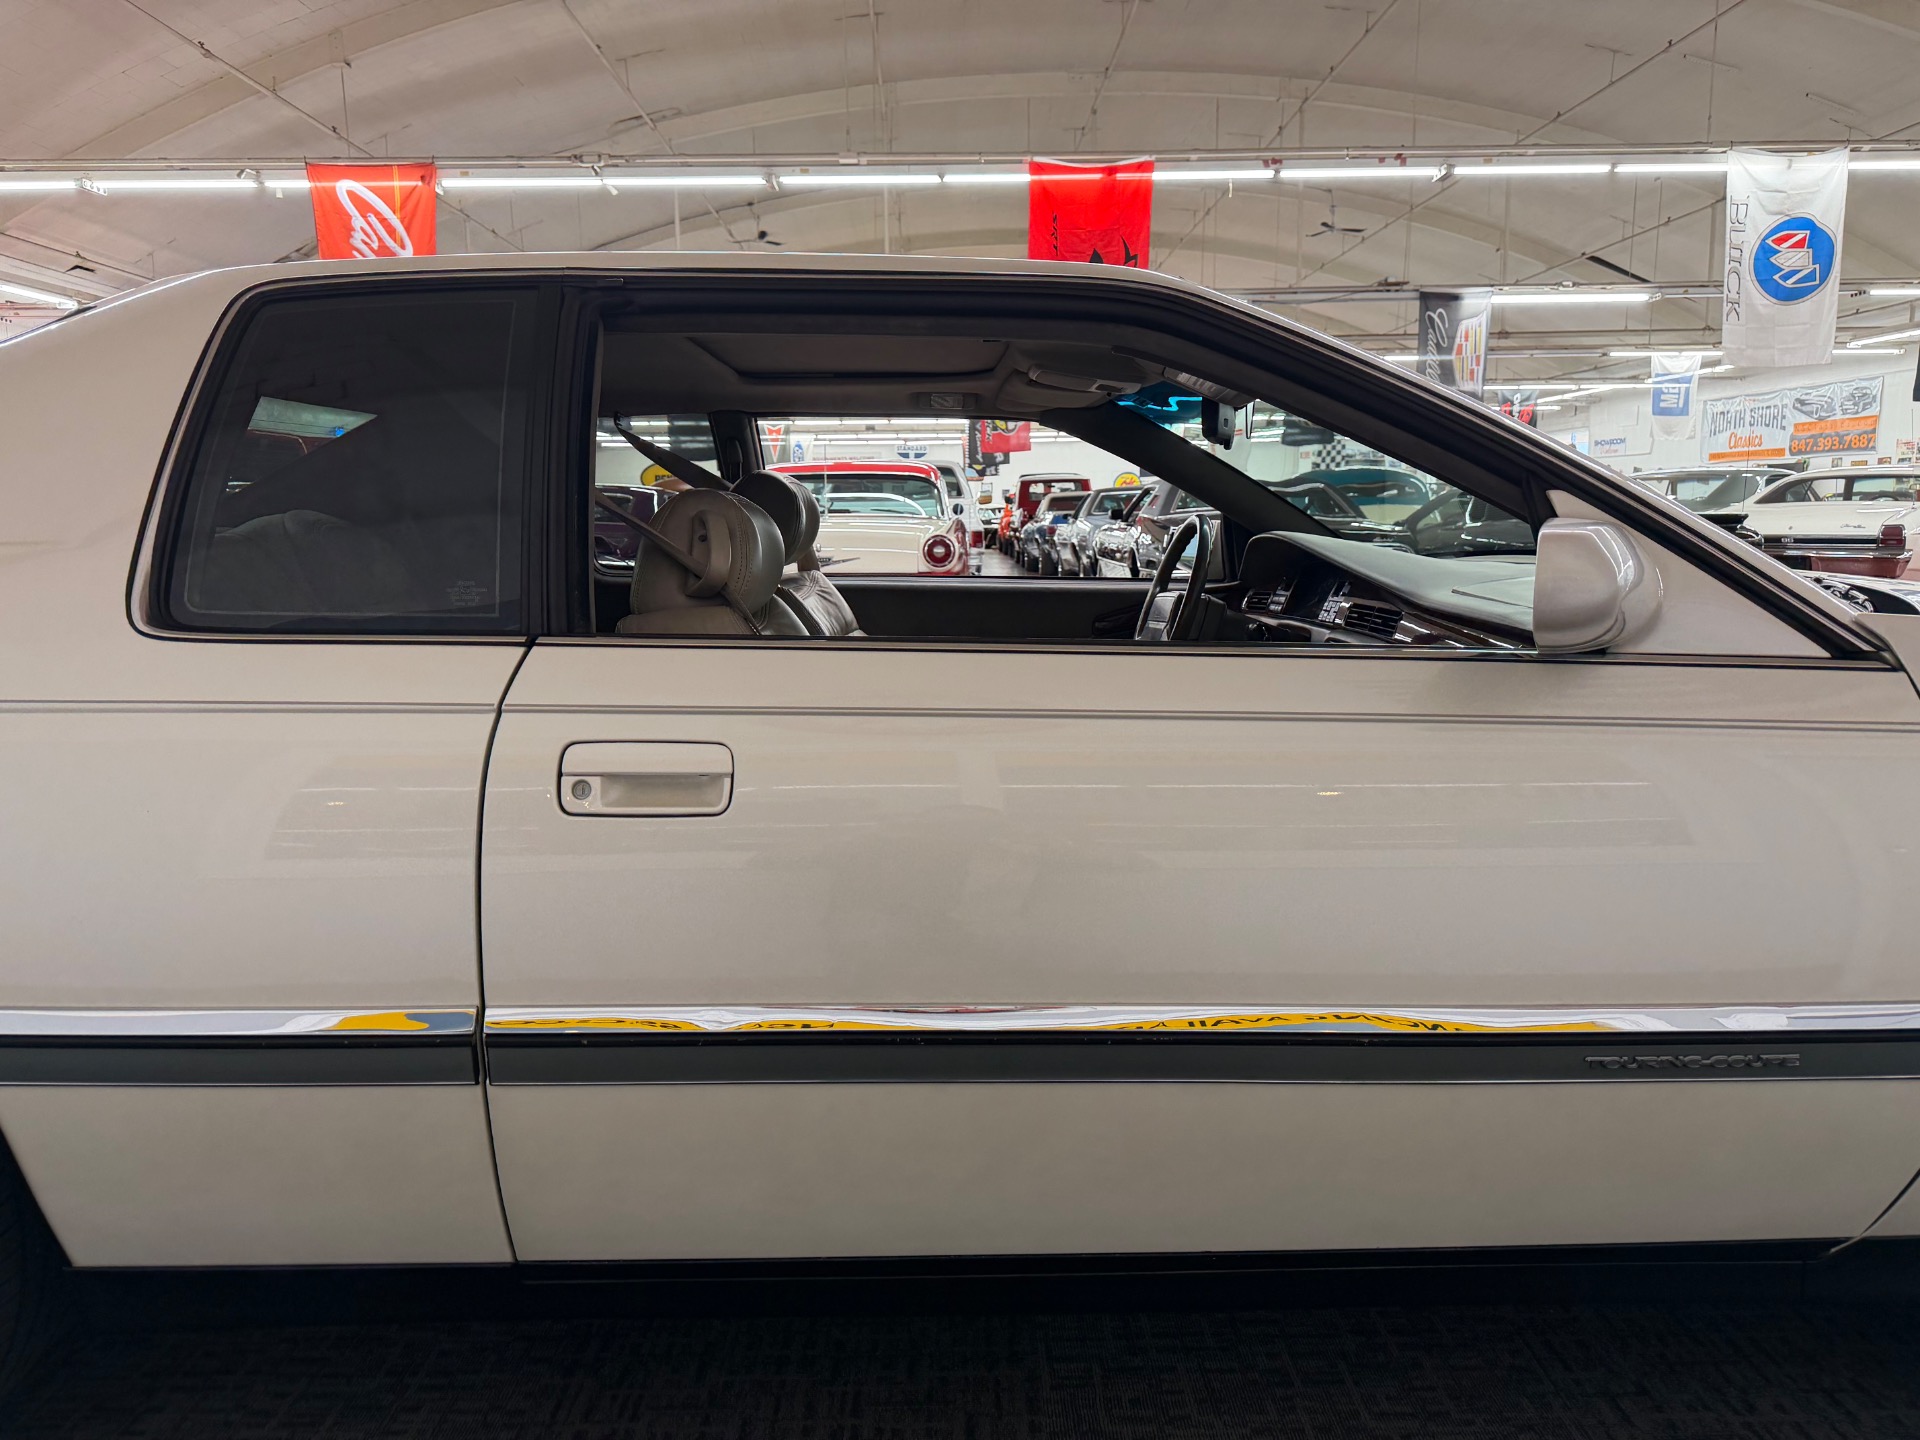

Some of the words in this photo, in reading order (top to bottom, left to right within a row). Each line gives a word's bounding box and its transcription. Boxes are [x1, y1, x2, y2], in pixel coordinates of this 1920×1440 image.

[1726, 195, 1750, 322] BUICK
[1709, 408, 1745, 437] NORTH
[1750, 404, 1786, 431] SHORE
[1728, 431, 1763, 449] Classics
[1791, 433, 1876, 453] 847.393.7887
